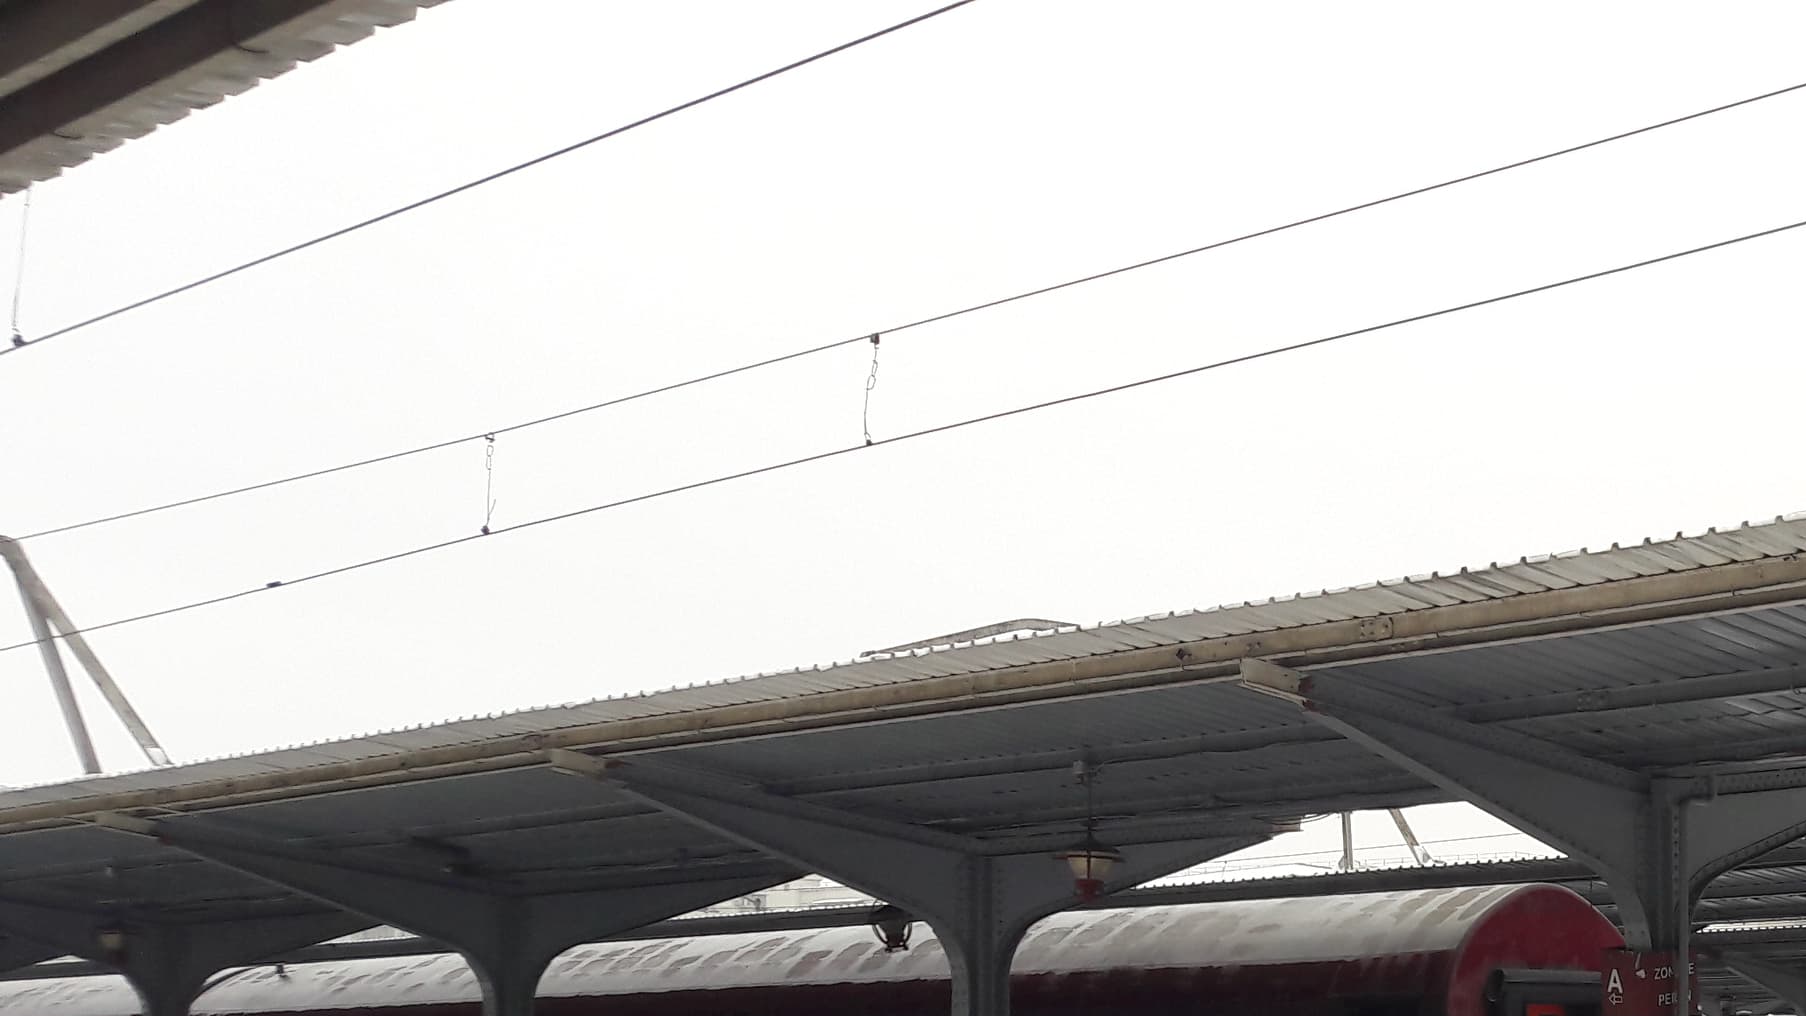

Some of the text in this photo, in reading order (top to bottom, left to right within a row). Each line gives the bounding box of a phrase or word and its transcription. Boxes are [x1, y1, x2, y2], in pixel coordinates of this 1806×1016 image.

[1654, 963, 1695, 980] ZONE
[1607, 969, 1623, 993] A
[1658, 990, 1692, 1006] PERN
